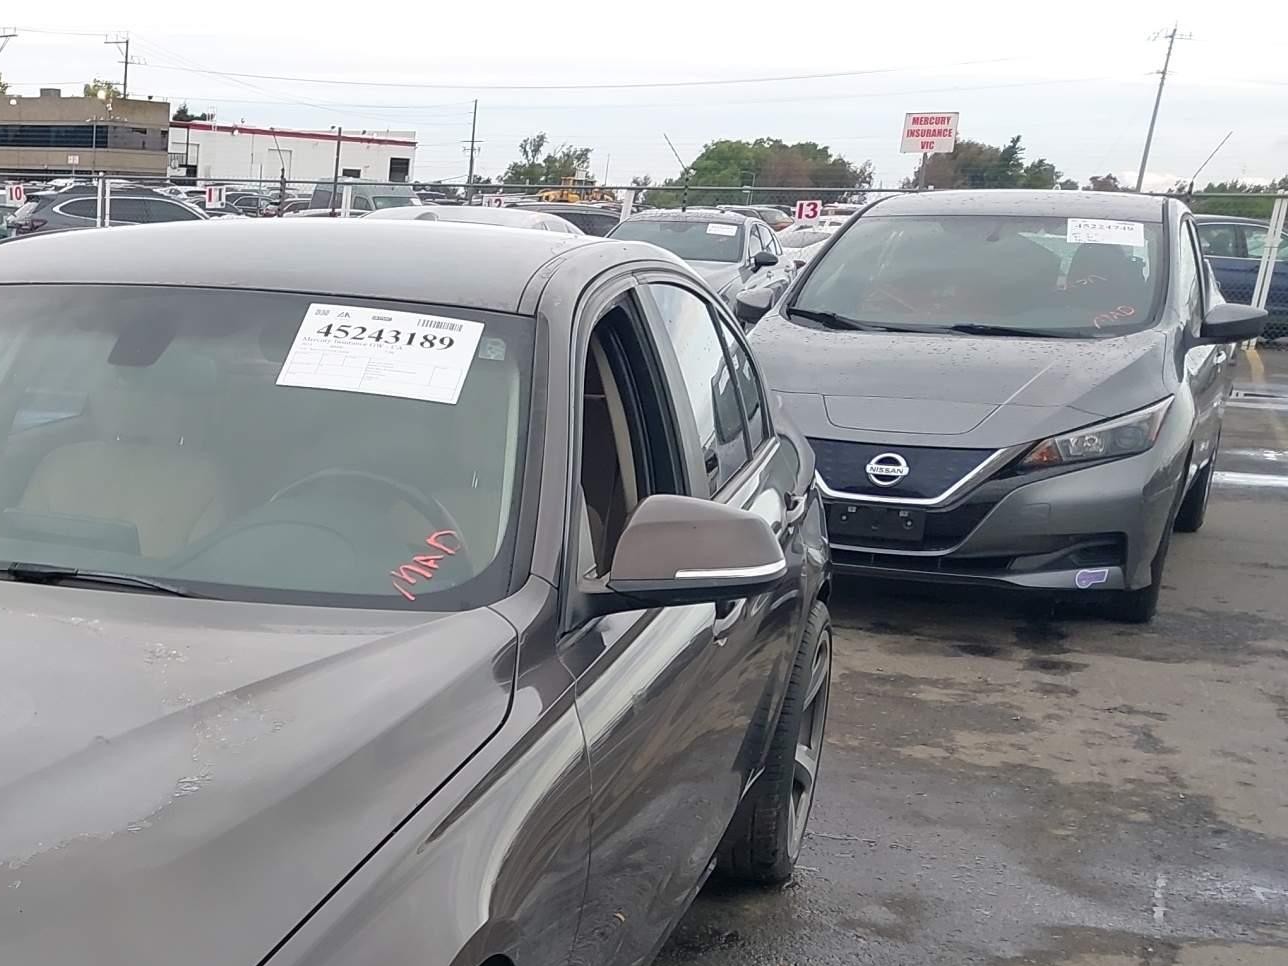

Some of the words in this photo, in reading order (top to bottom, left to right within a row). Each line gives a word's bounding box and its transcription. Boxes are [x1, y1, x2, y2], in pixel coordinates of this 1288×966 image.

[912, 116, 952, 126] MERCURY
[906, 129, 953, 138] INSURANCE
[920, 141, 935, 150] VIC
[10, 186, 22, 201] 10
[798, 202, 818, 219] 13
[316, 323, 454, 350] 45243189
[870, 466, 904, 474] NISSAN
